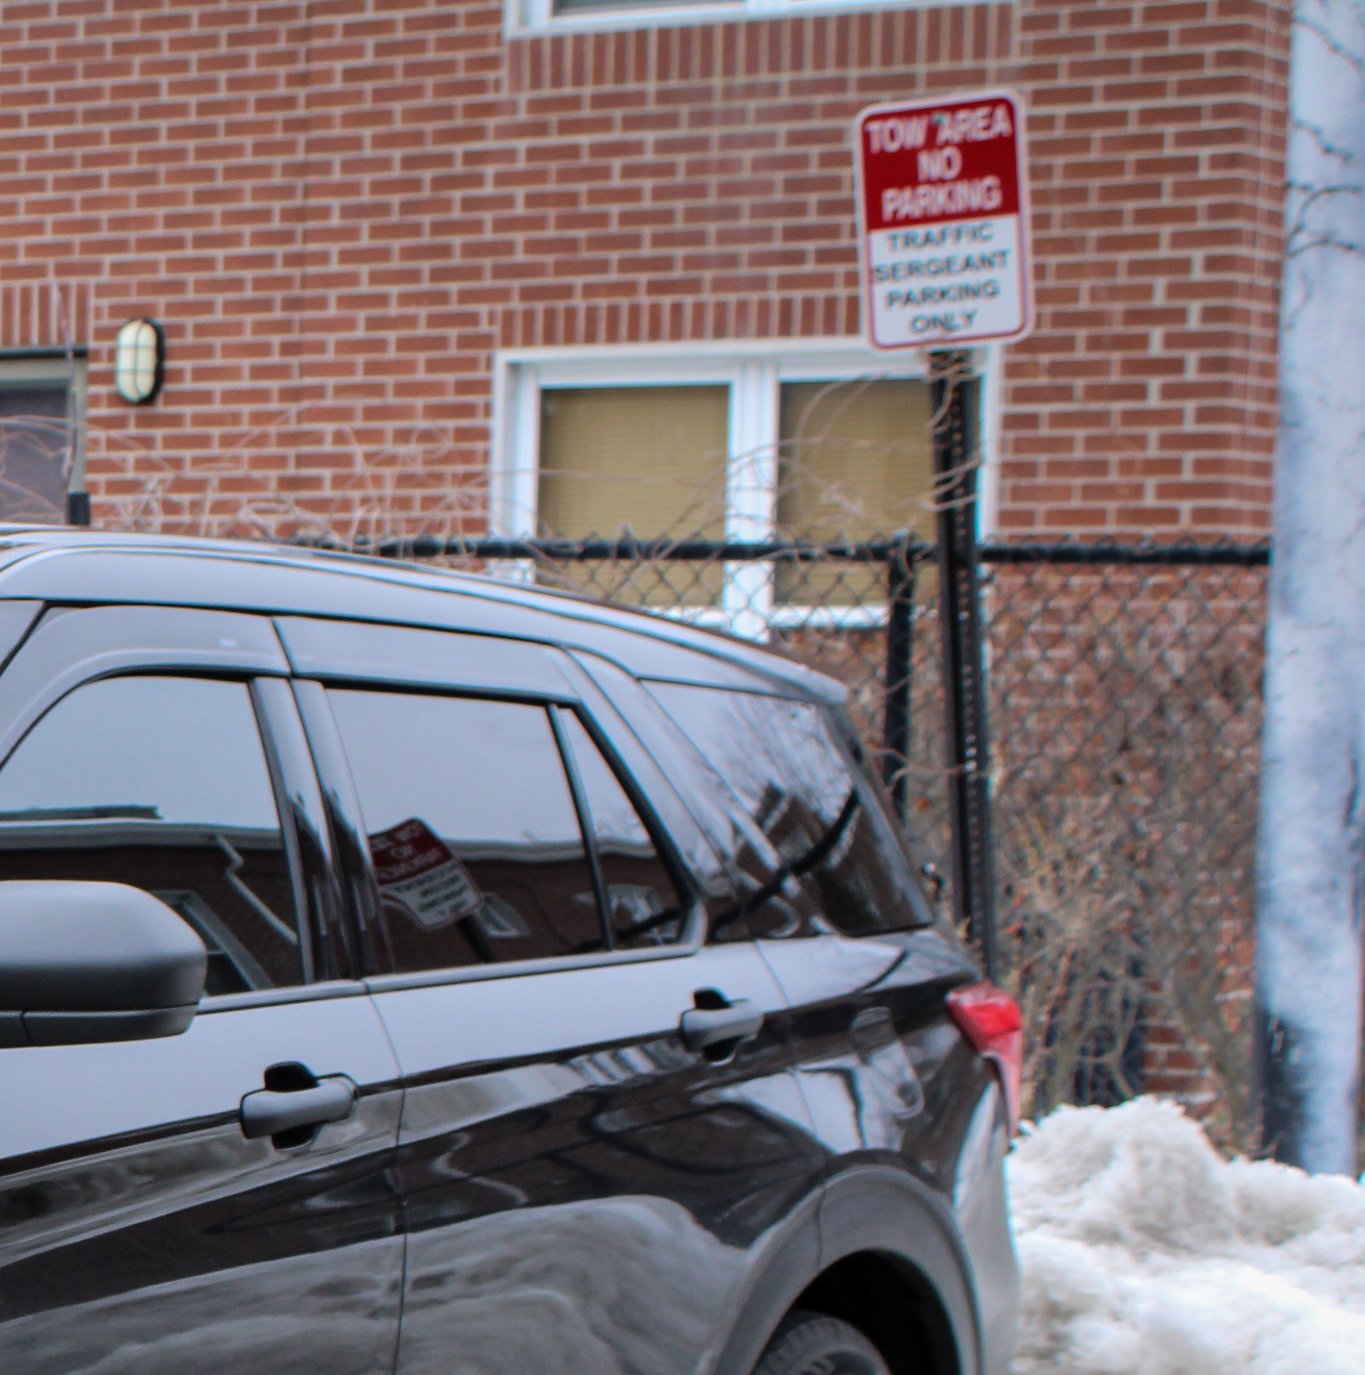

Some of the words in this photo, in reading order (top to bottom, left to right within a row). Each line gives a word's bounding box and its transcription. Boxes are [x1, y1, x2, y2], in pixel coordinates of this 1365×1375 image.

[866, 115, 927, 153] TOW
[935, 105, 1012, 145] AREA
[917, 146, 962, 182] NO
[881, 175, 1002, 222] PARKING
[887, 222, 994, 252] TRAFFIC
[873, 249, 1010, 282] SERGEANT
[886, 279, 1000, 309] PARKING
[911, 309, 978, 332] ONLY
